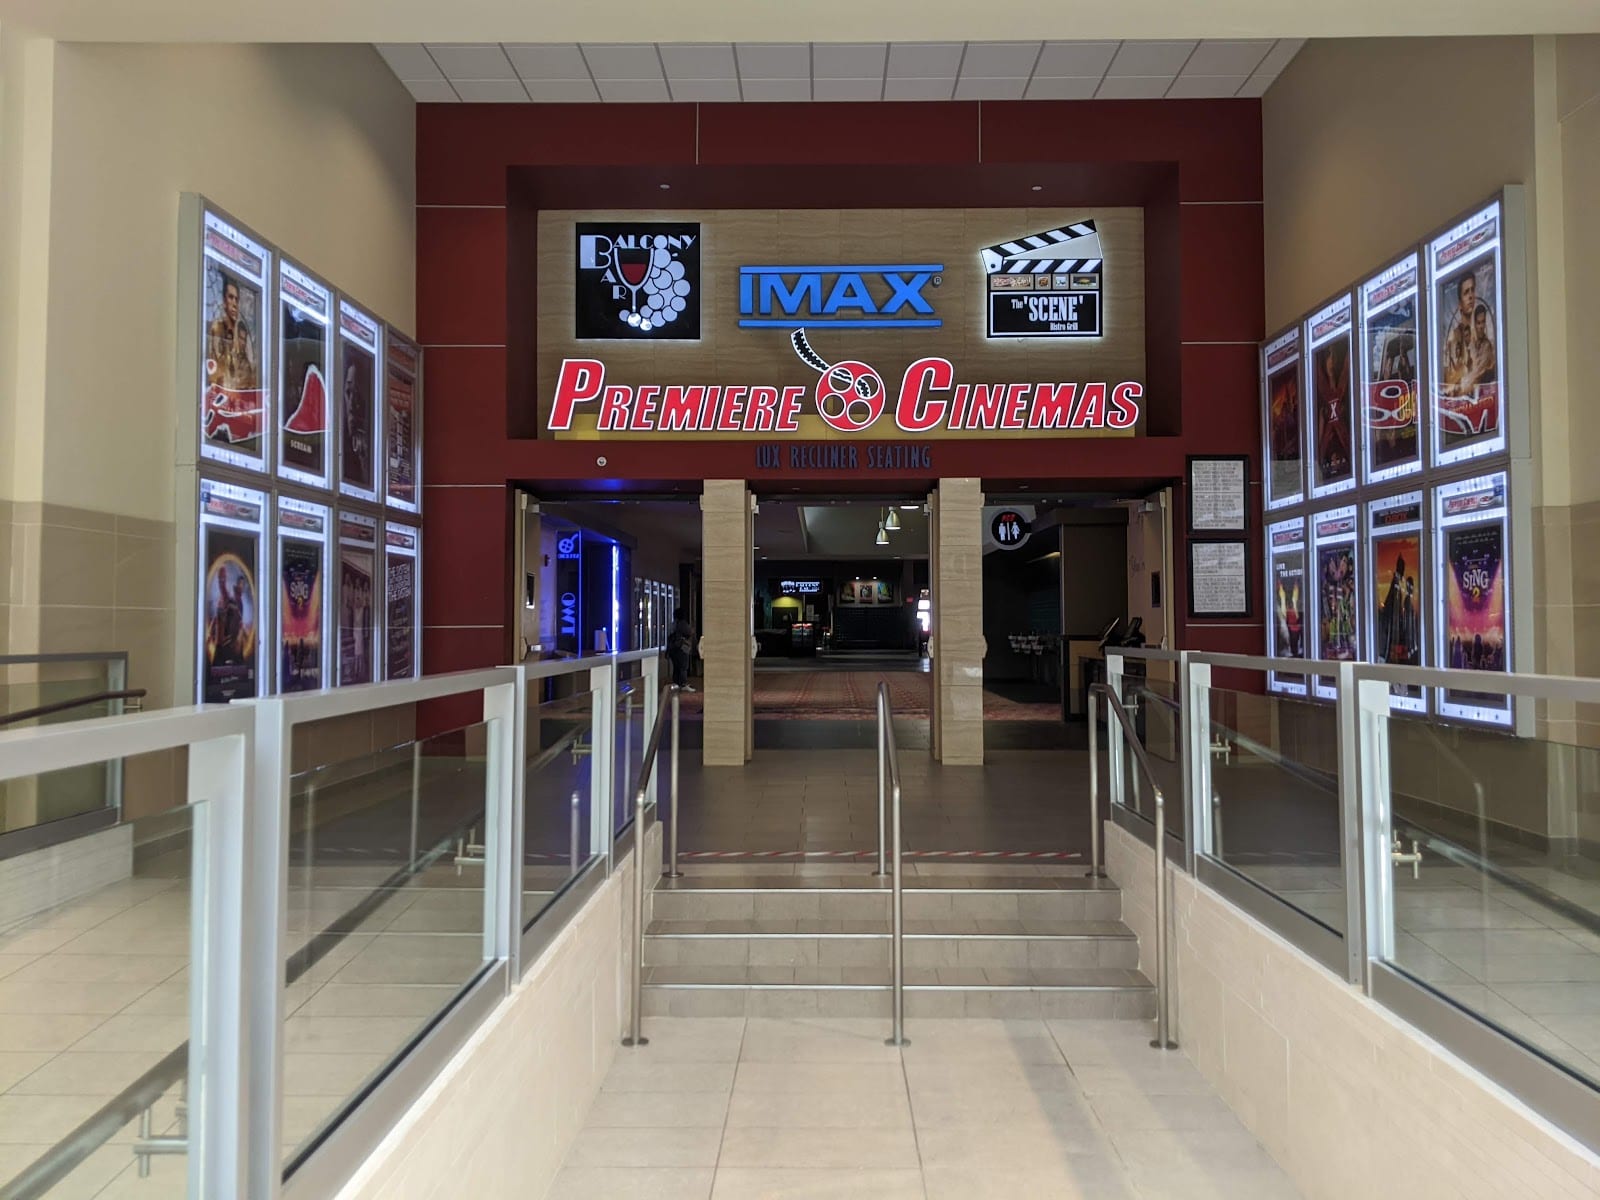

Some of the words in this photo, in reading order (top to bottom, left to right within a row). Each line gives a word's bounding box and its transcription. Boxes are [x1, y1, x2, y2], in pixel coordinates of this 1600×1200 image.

[580, 234, 696, 268] BALCONY
[739, 272, 935, 315] IMAX
[1011, 298, 1023, 309] The
[1066, 322, 1079, 331] Grill
[547, 358, 806, 432] PREMIERE
[895, 356, 1144, 432] CINEMAS
[756, 446, 780, 468] LUX
[791, 446, 858, 468] RECLINER
[867, 446, 931, 468] SEATING
[1462, 568, 1489, 591] SING
[1472, 586, 1481, 602] 2
